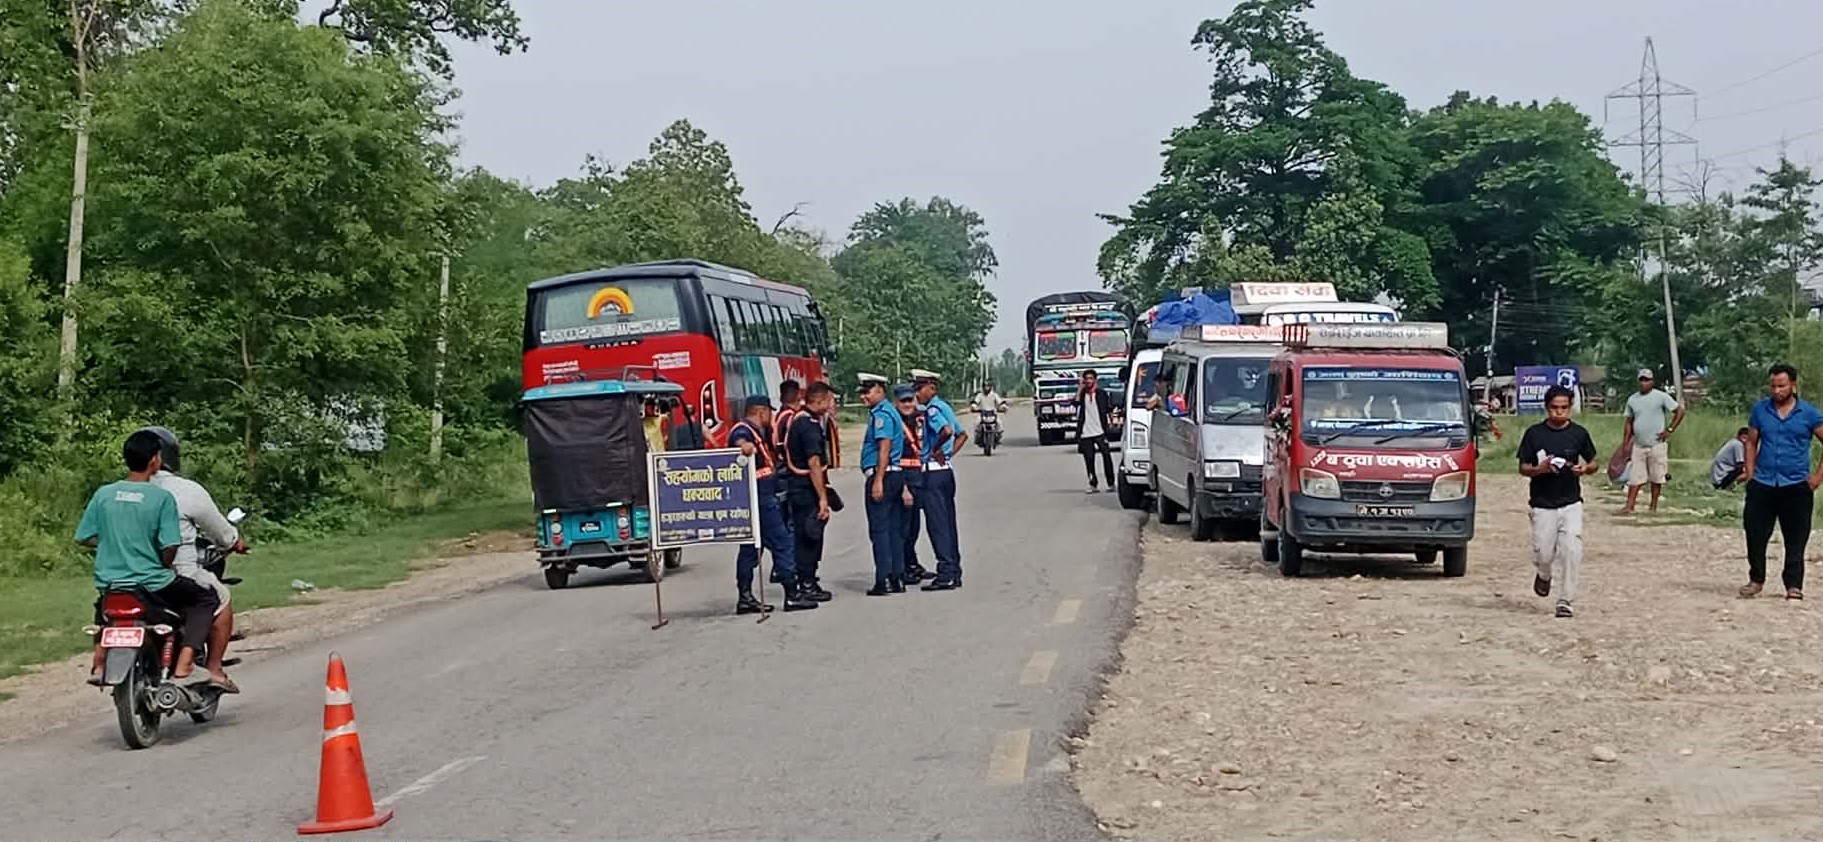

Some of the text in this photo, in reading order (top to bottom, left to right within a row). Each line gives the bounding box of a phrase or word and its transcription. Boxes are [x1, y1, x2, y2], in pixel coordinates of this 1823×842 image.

[664, 463, 742, 484] सहयोगको लागि
[682, 488, 724, 501] धन्यवाद
